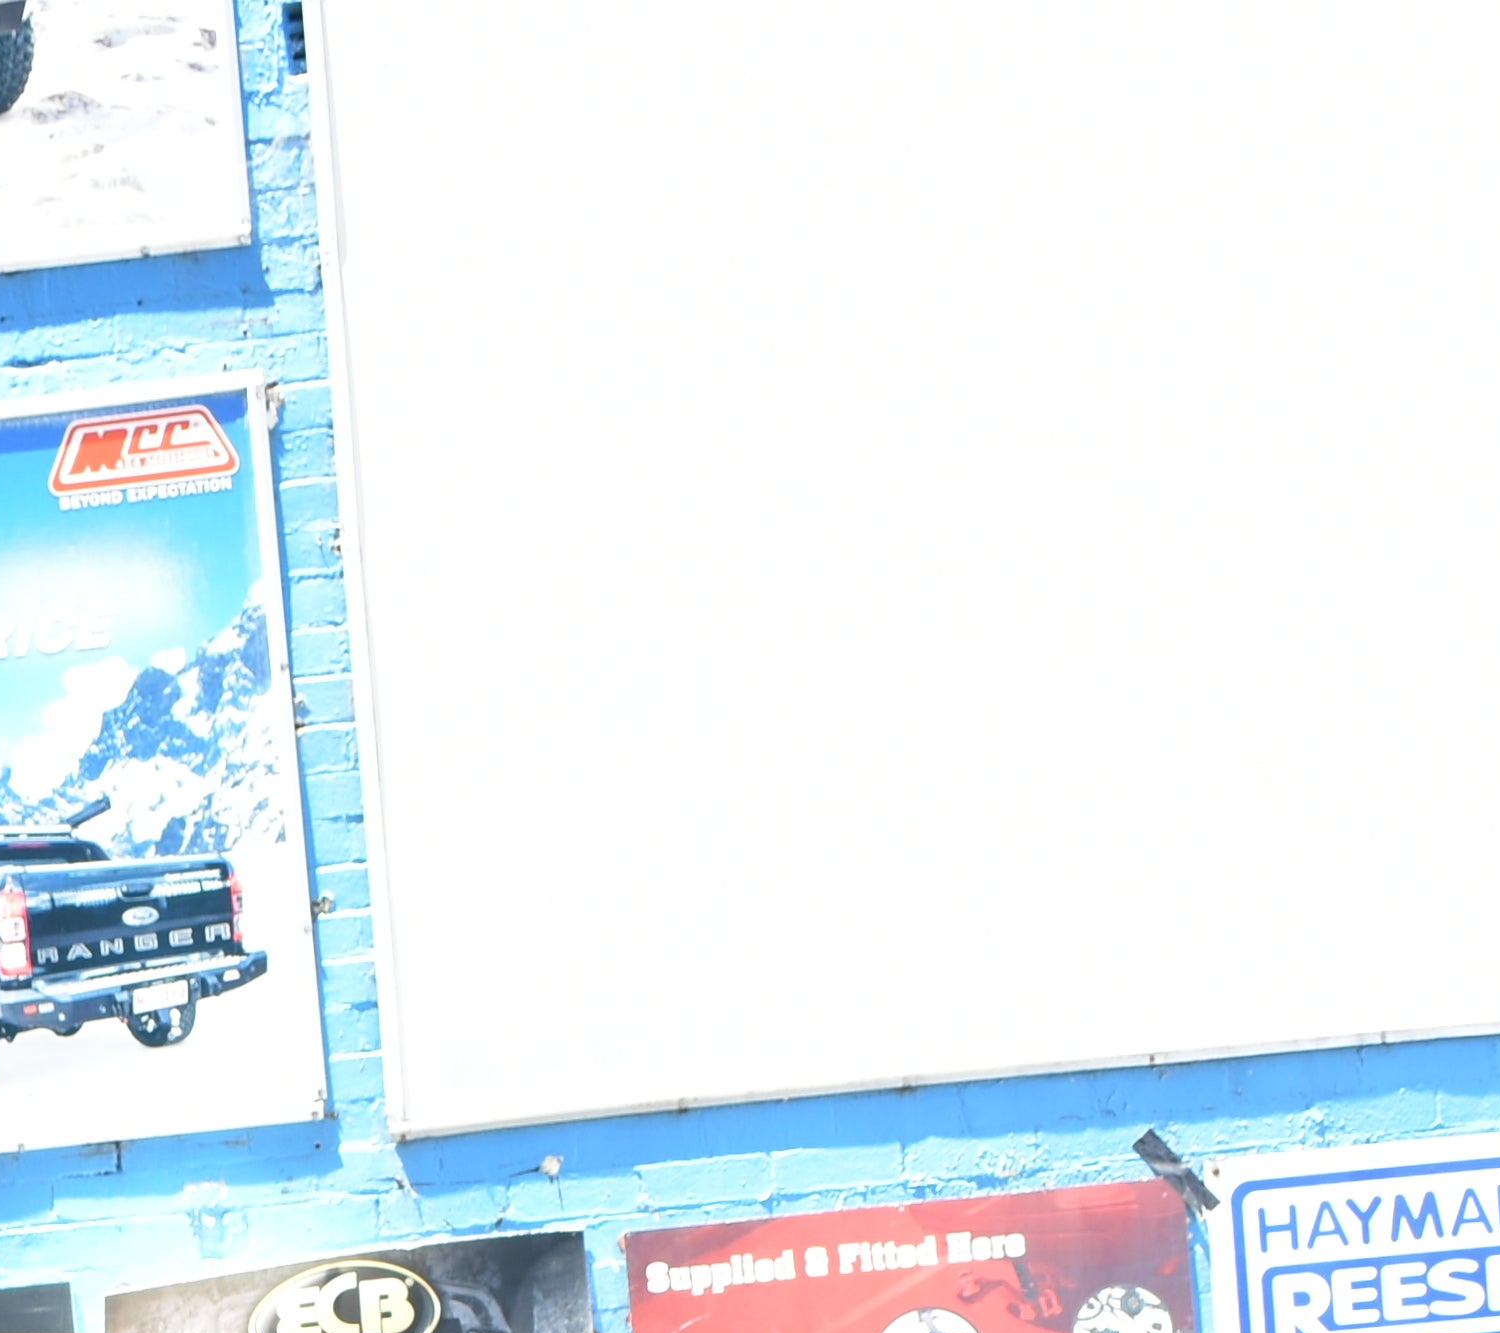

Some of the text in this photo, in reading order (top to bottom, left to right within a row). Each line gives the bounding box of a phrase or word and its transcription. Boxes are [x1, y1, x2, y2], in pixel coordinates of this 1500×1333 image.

[68, 419, 191, 476] MCC
[59, 477, 233, 512] BEYOND EXPECTATION
[37, 922, 232, 965] RANGER
[645, 1230, 1027, 1297] Supplied & Fitted Here
